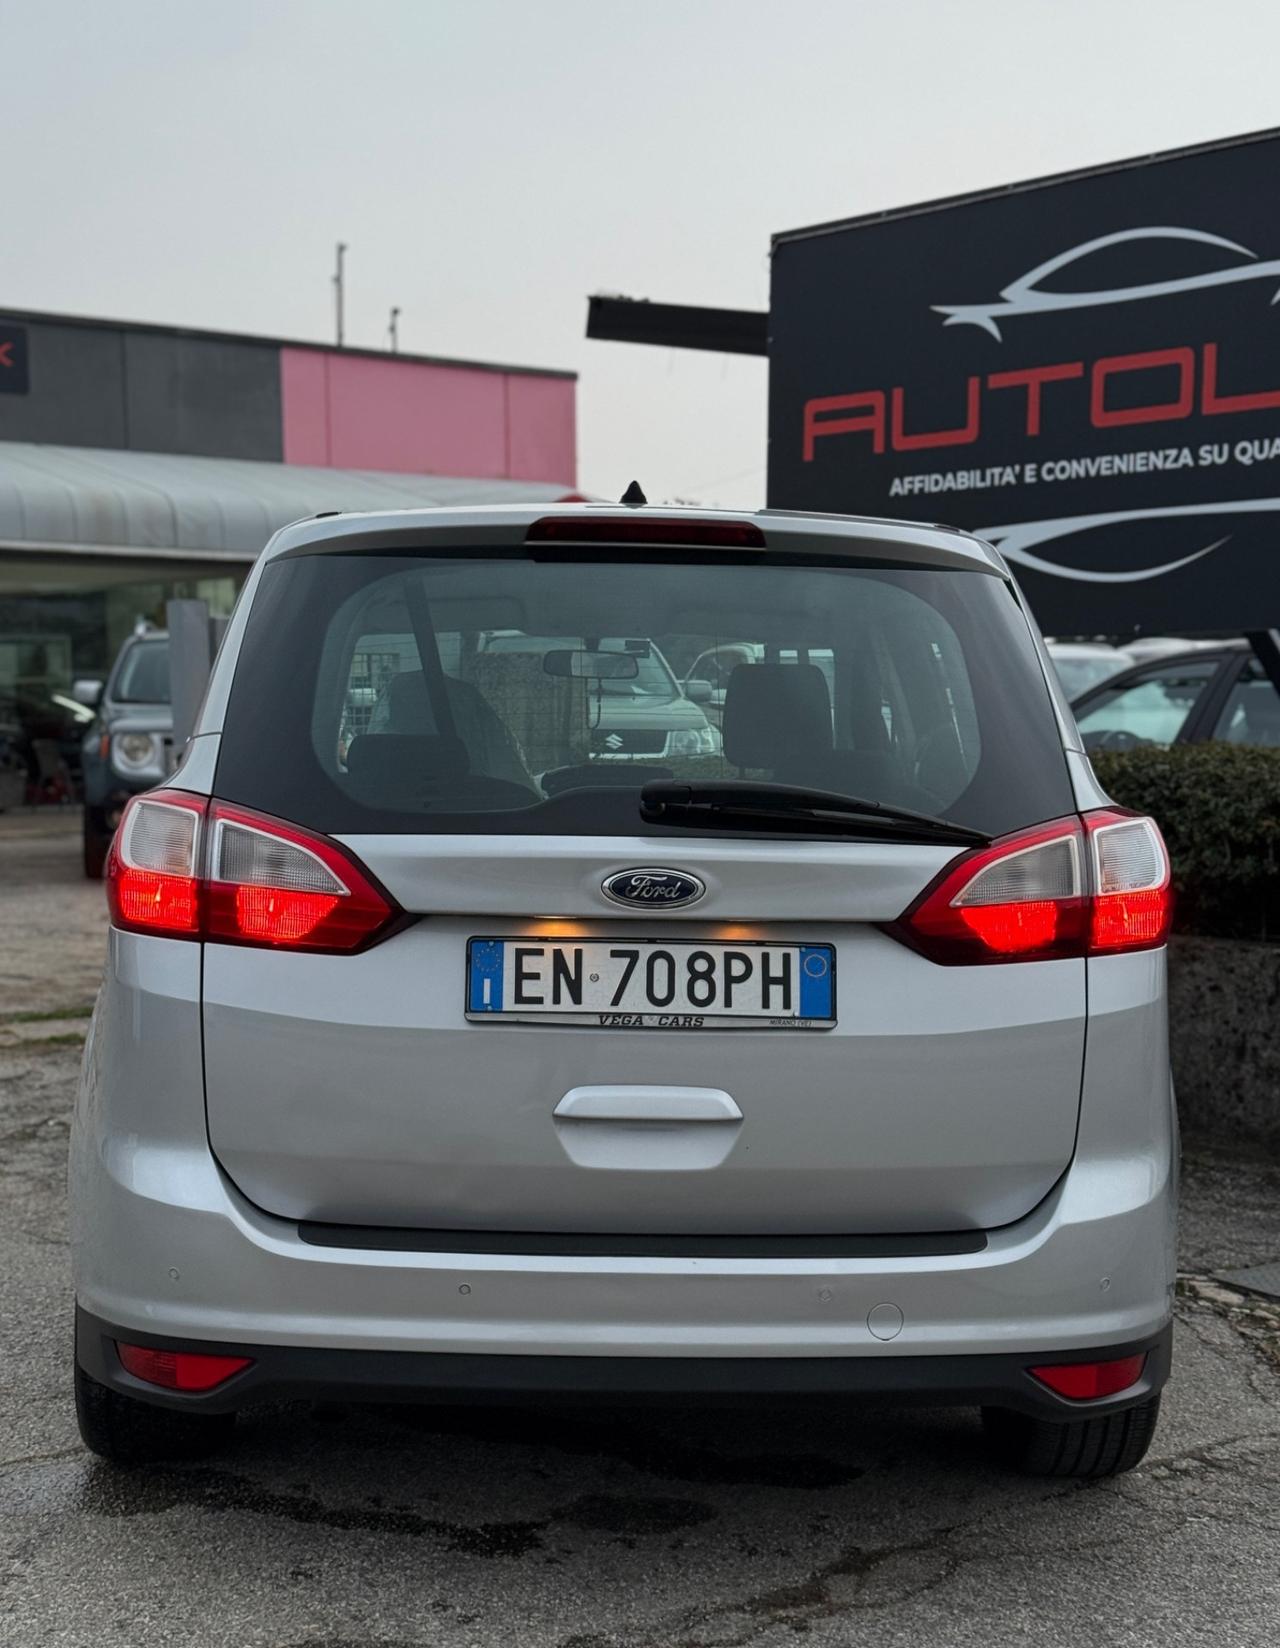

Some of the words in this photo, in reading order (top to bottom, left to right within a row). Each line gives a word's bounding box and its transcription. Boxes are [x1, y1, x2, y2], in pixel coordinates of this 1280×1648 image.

[889, 465, 1020, 497] AFFIDABILITA'
[1024, 464, 1037, 483] E
[1041, 448, 1194, 482] CONVENIENZA
[1198, 444, 1229, 467] SU
[625, 875, 682, 898] Ford
[514, 948, 583, 1005] EN
[609, 950, 792, 1010] 708PH
[598, 1015, 644, 1027] VEGA
[658, 1016, 705, 1028] CARS
